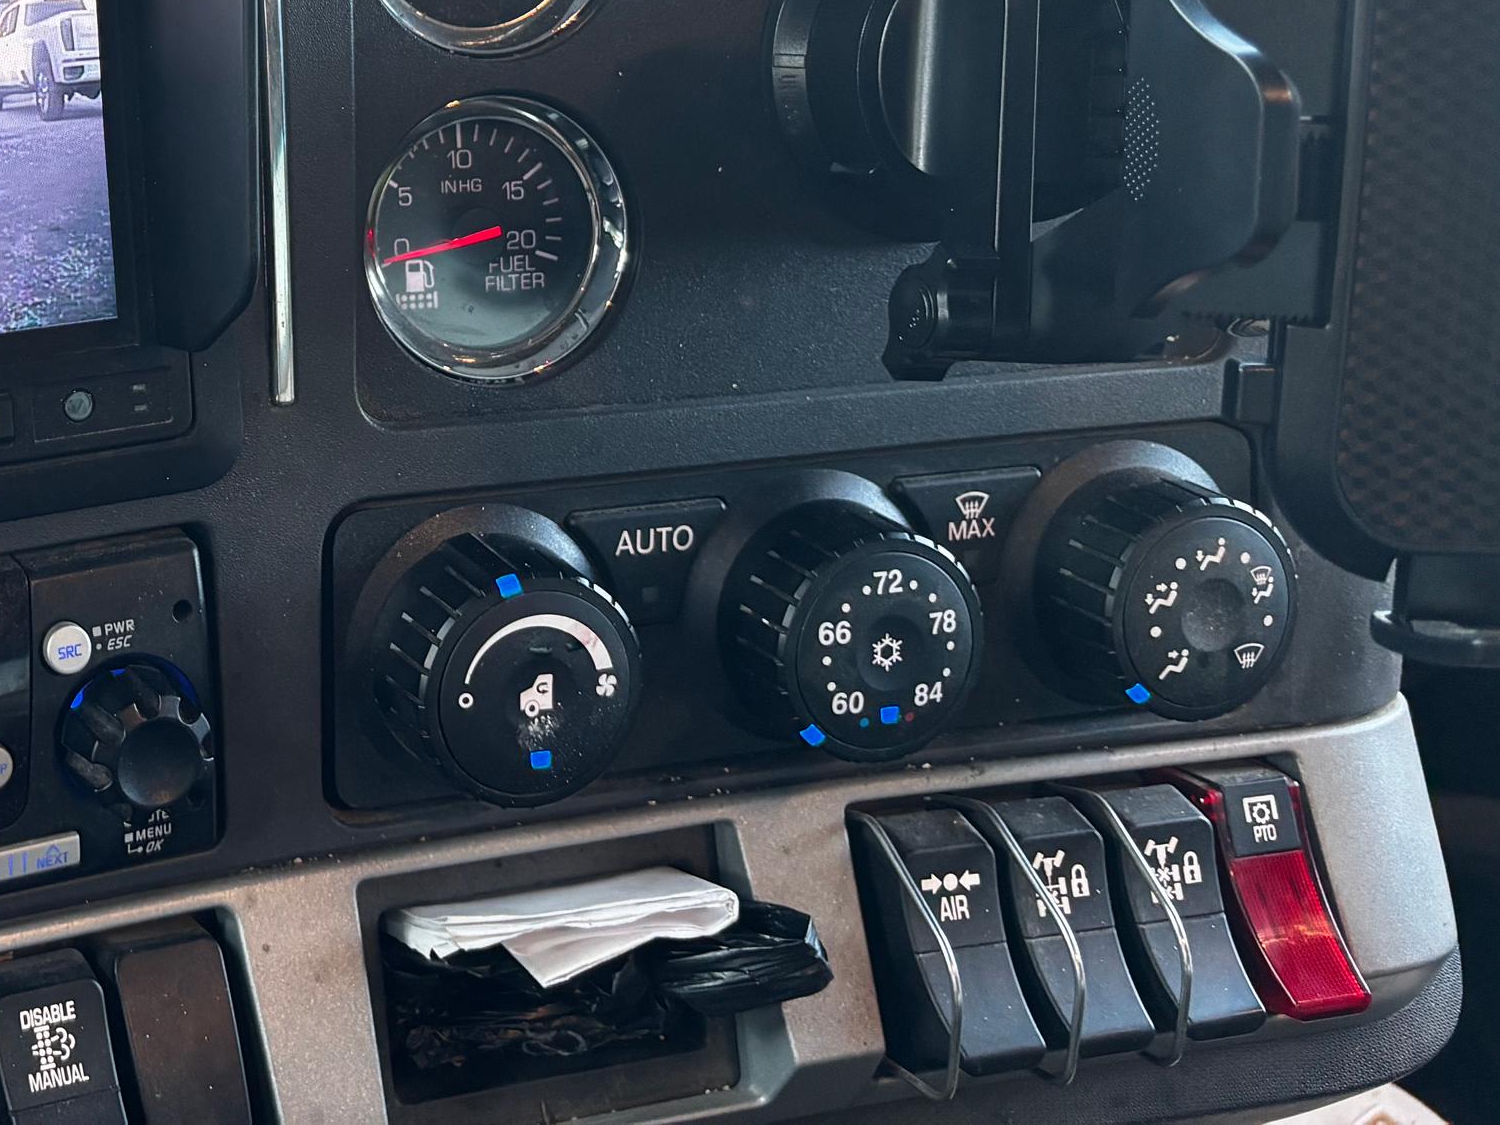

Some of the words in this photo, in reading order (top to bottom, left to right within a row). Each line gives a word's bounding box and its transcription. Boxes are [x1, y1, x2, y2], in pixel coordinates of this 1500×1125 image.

[447, 149, 472, 169] 10
[398, 187, 412, 207] 5
[502, 181, 524, 201] 15
[394, 238, 410, 257] 0
[506, 229, 536, 250] 20
[489, 255, 535, 274] FUEL
[485, 273, 545, 292] FILTER
[948, 518, 995, 541] MAX
[615, 525, 694, 556] AUTO
[873, 569, 903, 595] 72
[105, 619, 135, 636] PWR
[929, 610, 956, 635] 78
[107, 635, 132, 651] ESC
[818, 621, 851, 646] 66
[58, 644, 82, 660] SRC
[831, 691, 864, 715] 60
[914, 682, 943, 706] 84
[135, 823, 171, 841] MENU
[1253, 824, 1277, 843] PTO
[146, 838, 164, 853] OK
[36, 851, 69, 870] NEXT
[940, 895, 970, 922] AIR
[20, 1000, 76, 1030] DISABLE
[28, 1063, 90, 1093] MANUAL
